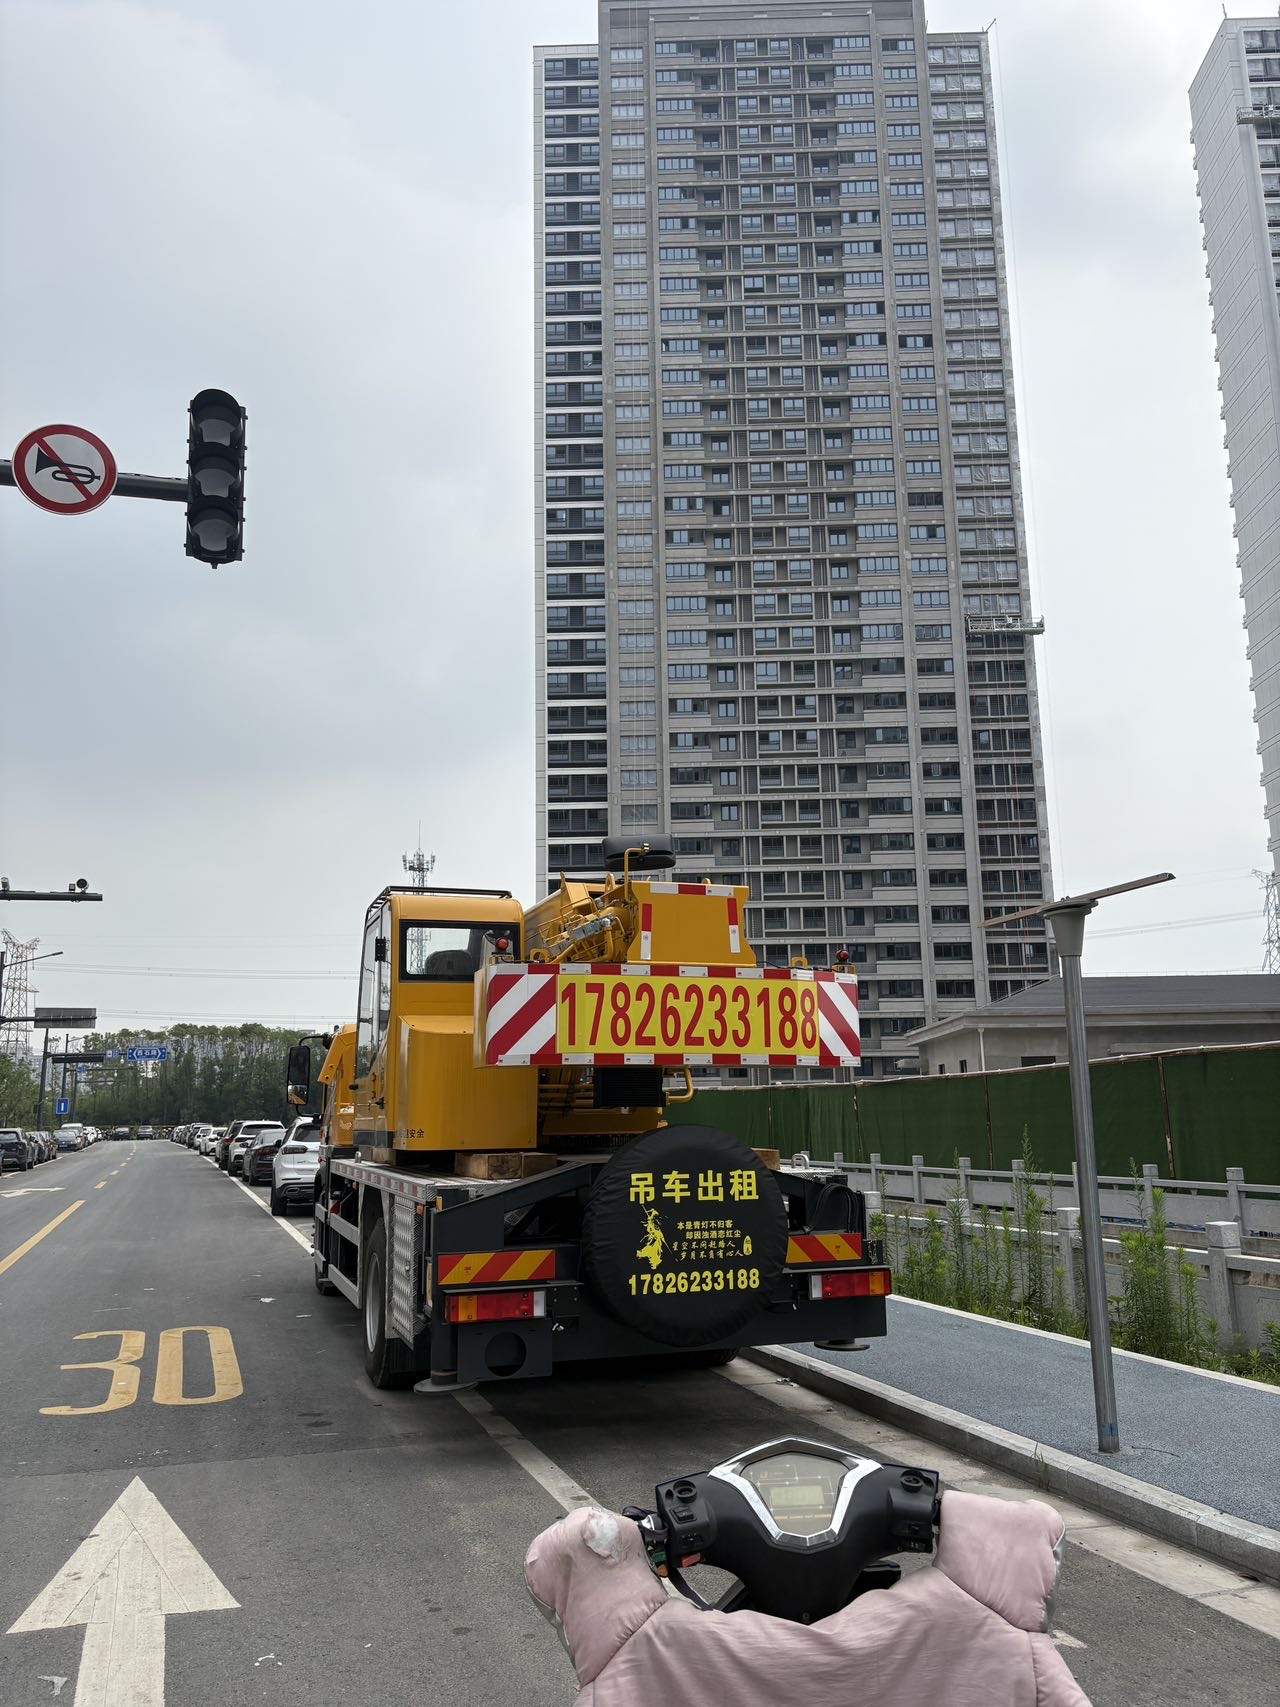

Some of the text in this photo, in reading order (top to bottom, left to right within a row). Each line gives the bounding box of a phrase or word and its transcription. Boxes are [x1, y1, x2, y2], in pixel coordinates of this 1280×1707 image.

[561, 981, 818, 1049] 17826233188
[629, 1169, 759, 1205] 吊车出租
[628, 1268, 760, 1296] 17826233188
[38, 1325, 244, 1416] 30
